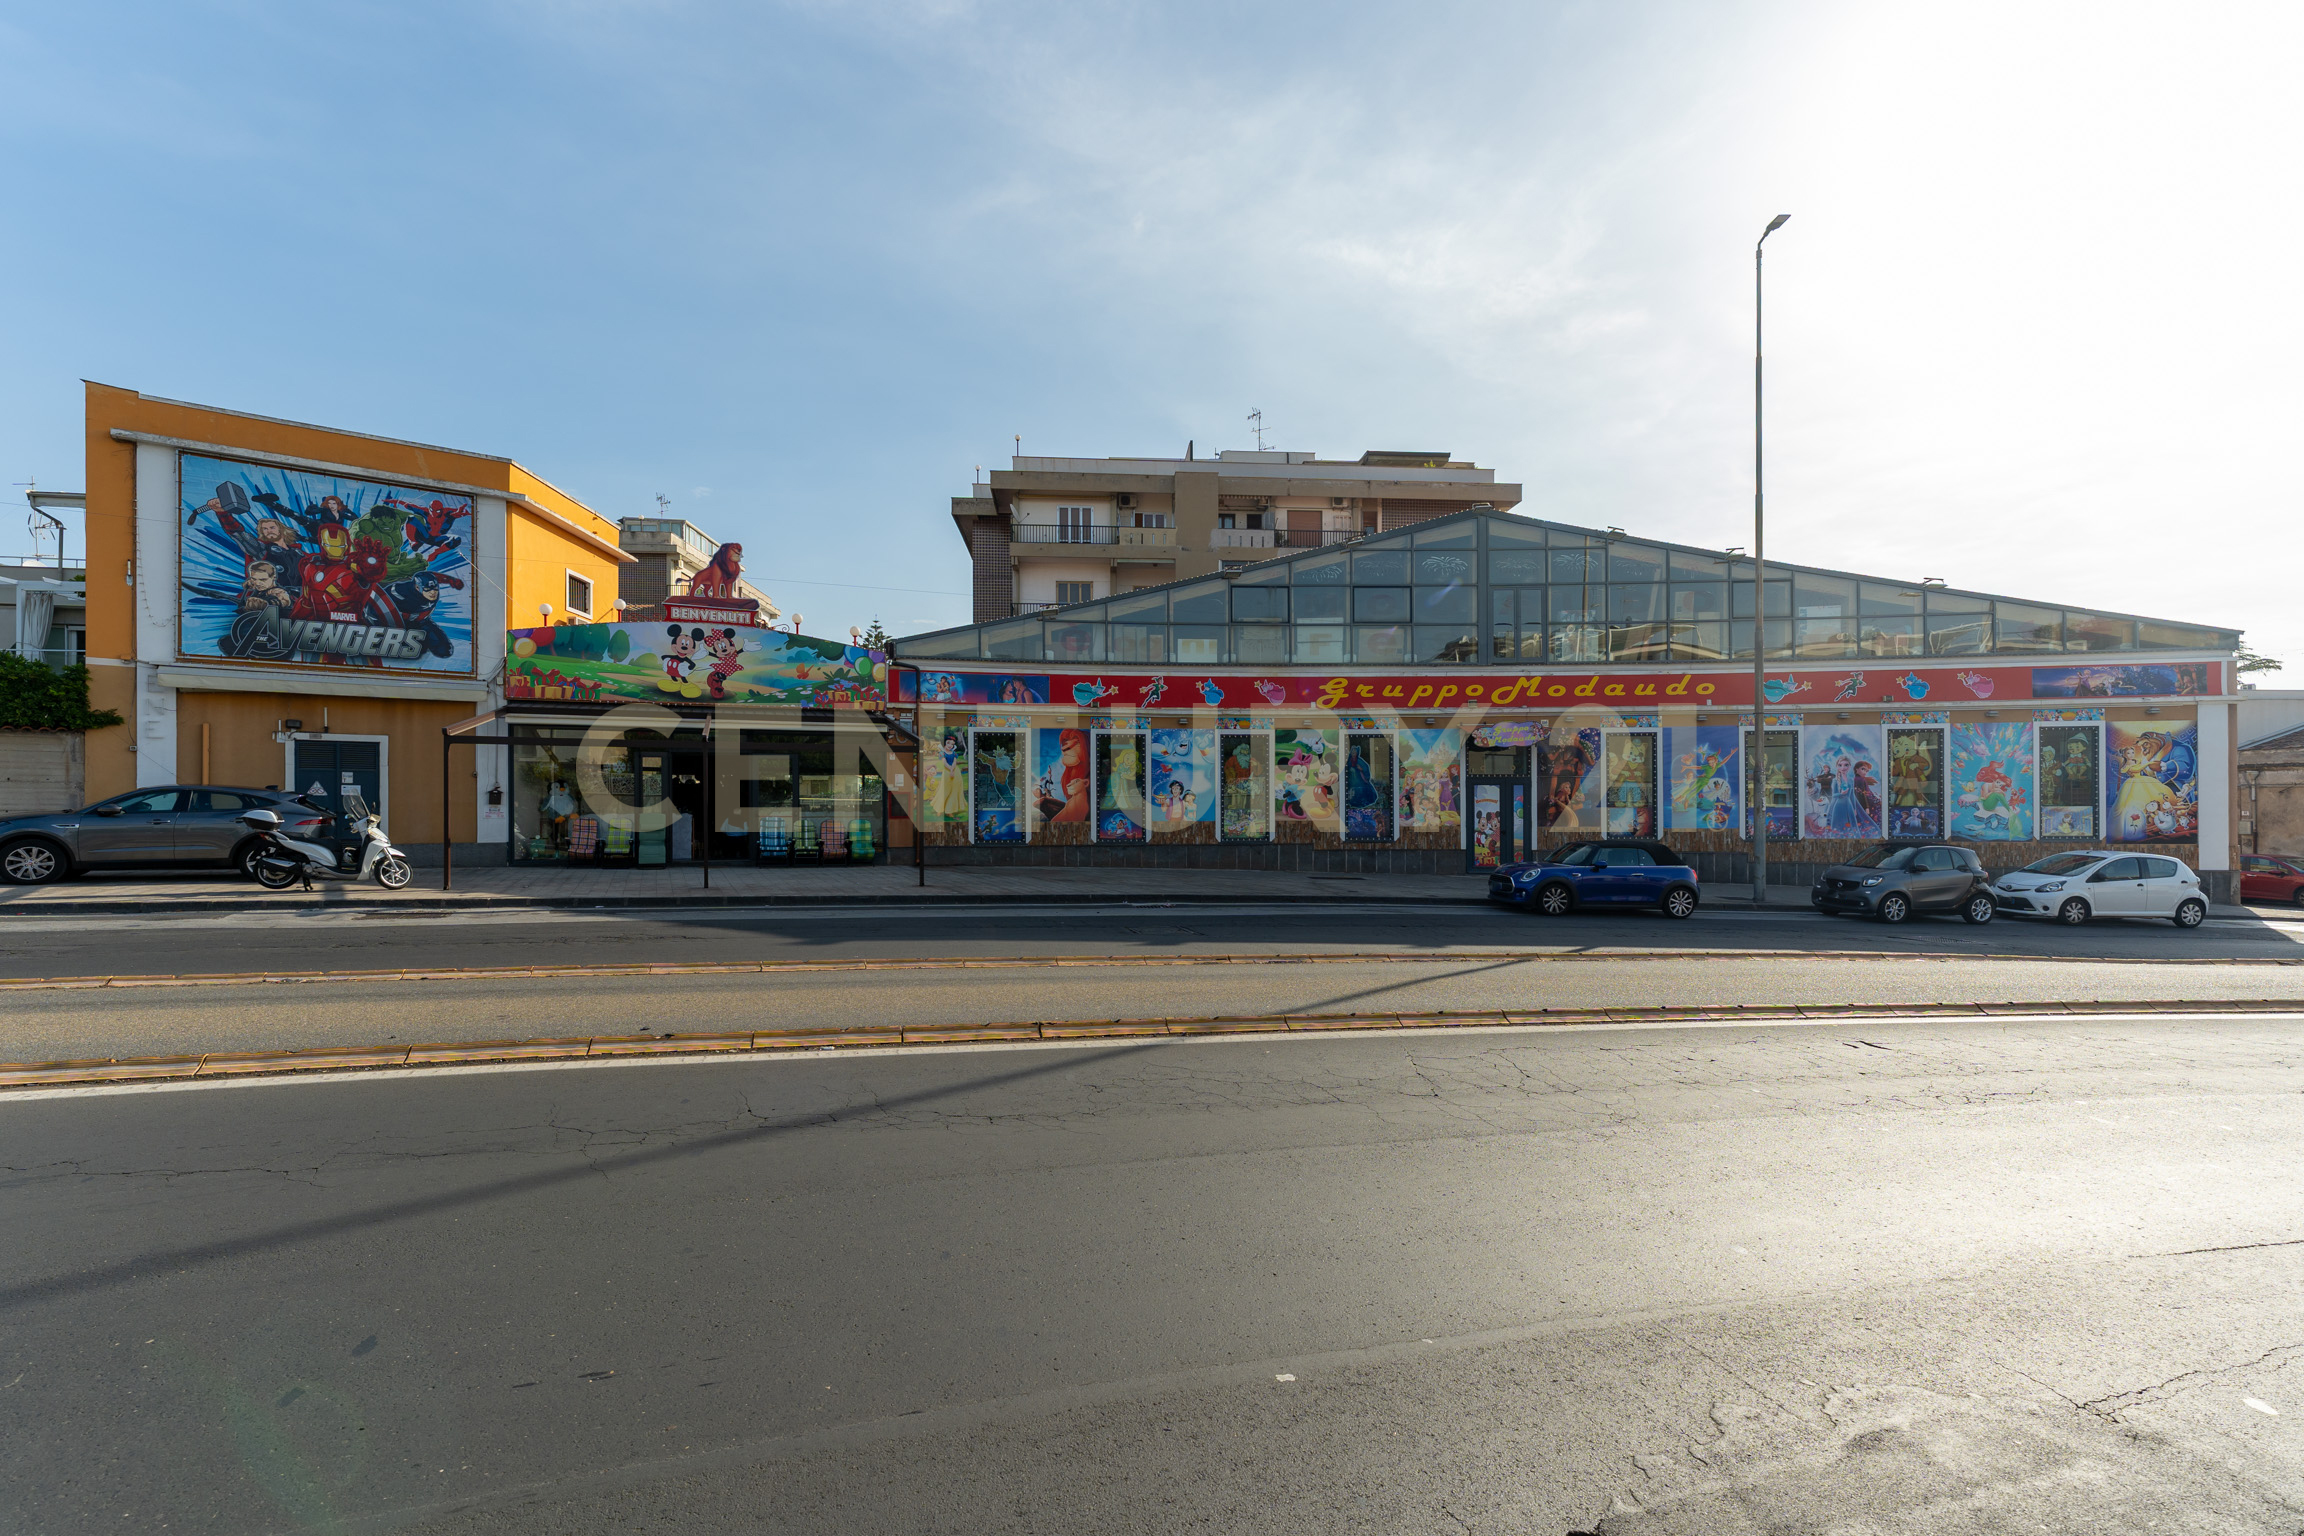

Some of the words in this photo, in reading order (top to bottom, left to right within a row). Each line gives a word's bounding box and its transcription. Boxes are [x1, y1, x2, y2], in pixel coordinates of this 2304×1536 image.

[331, 612, 358, 622] MARVEL
[670, 606, 752, 625] BENVENUTI
[232, 605, 427, 659] AVENGERS
[1316, 677, 1484, 709] Gruppo
[1490, 674, 1717, 705] Modaudo
[1493, 726, 1529, 736] Gruppo
[1489, 734, 1536, 745] Modaudo
